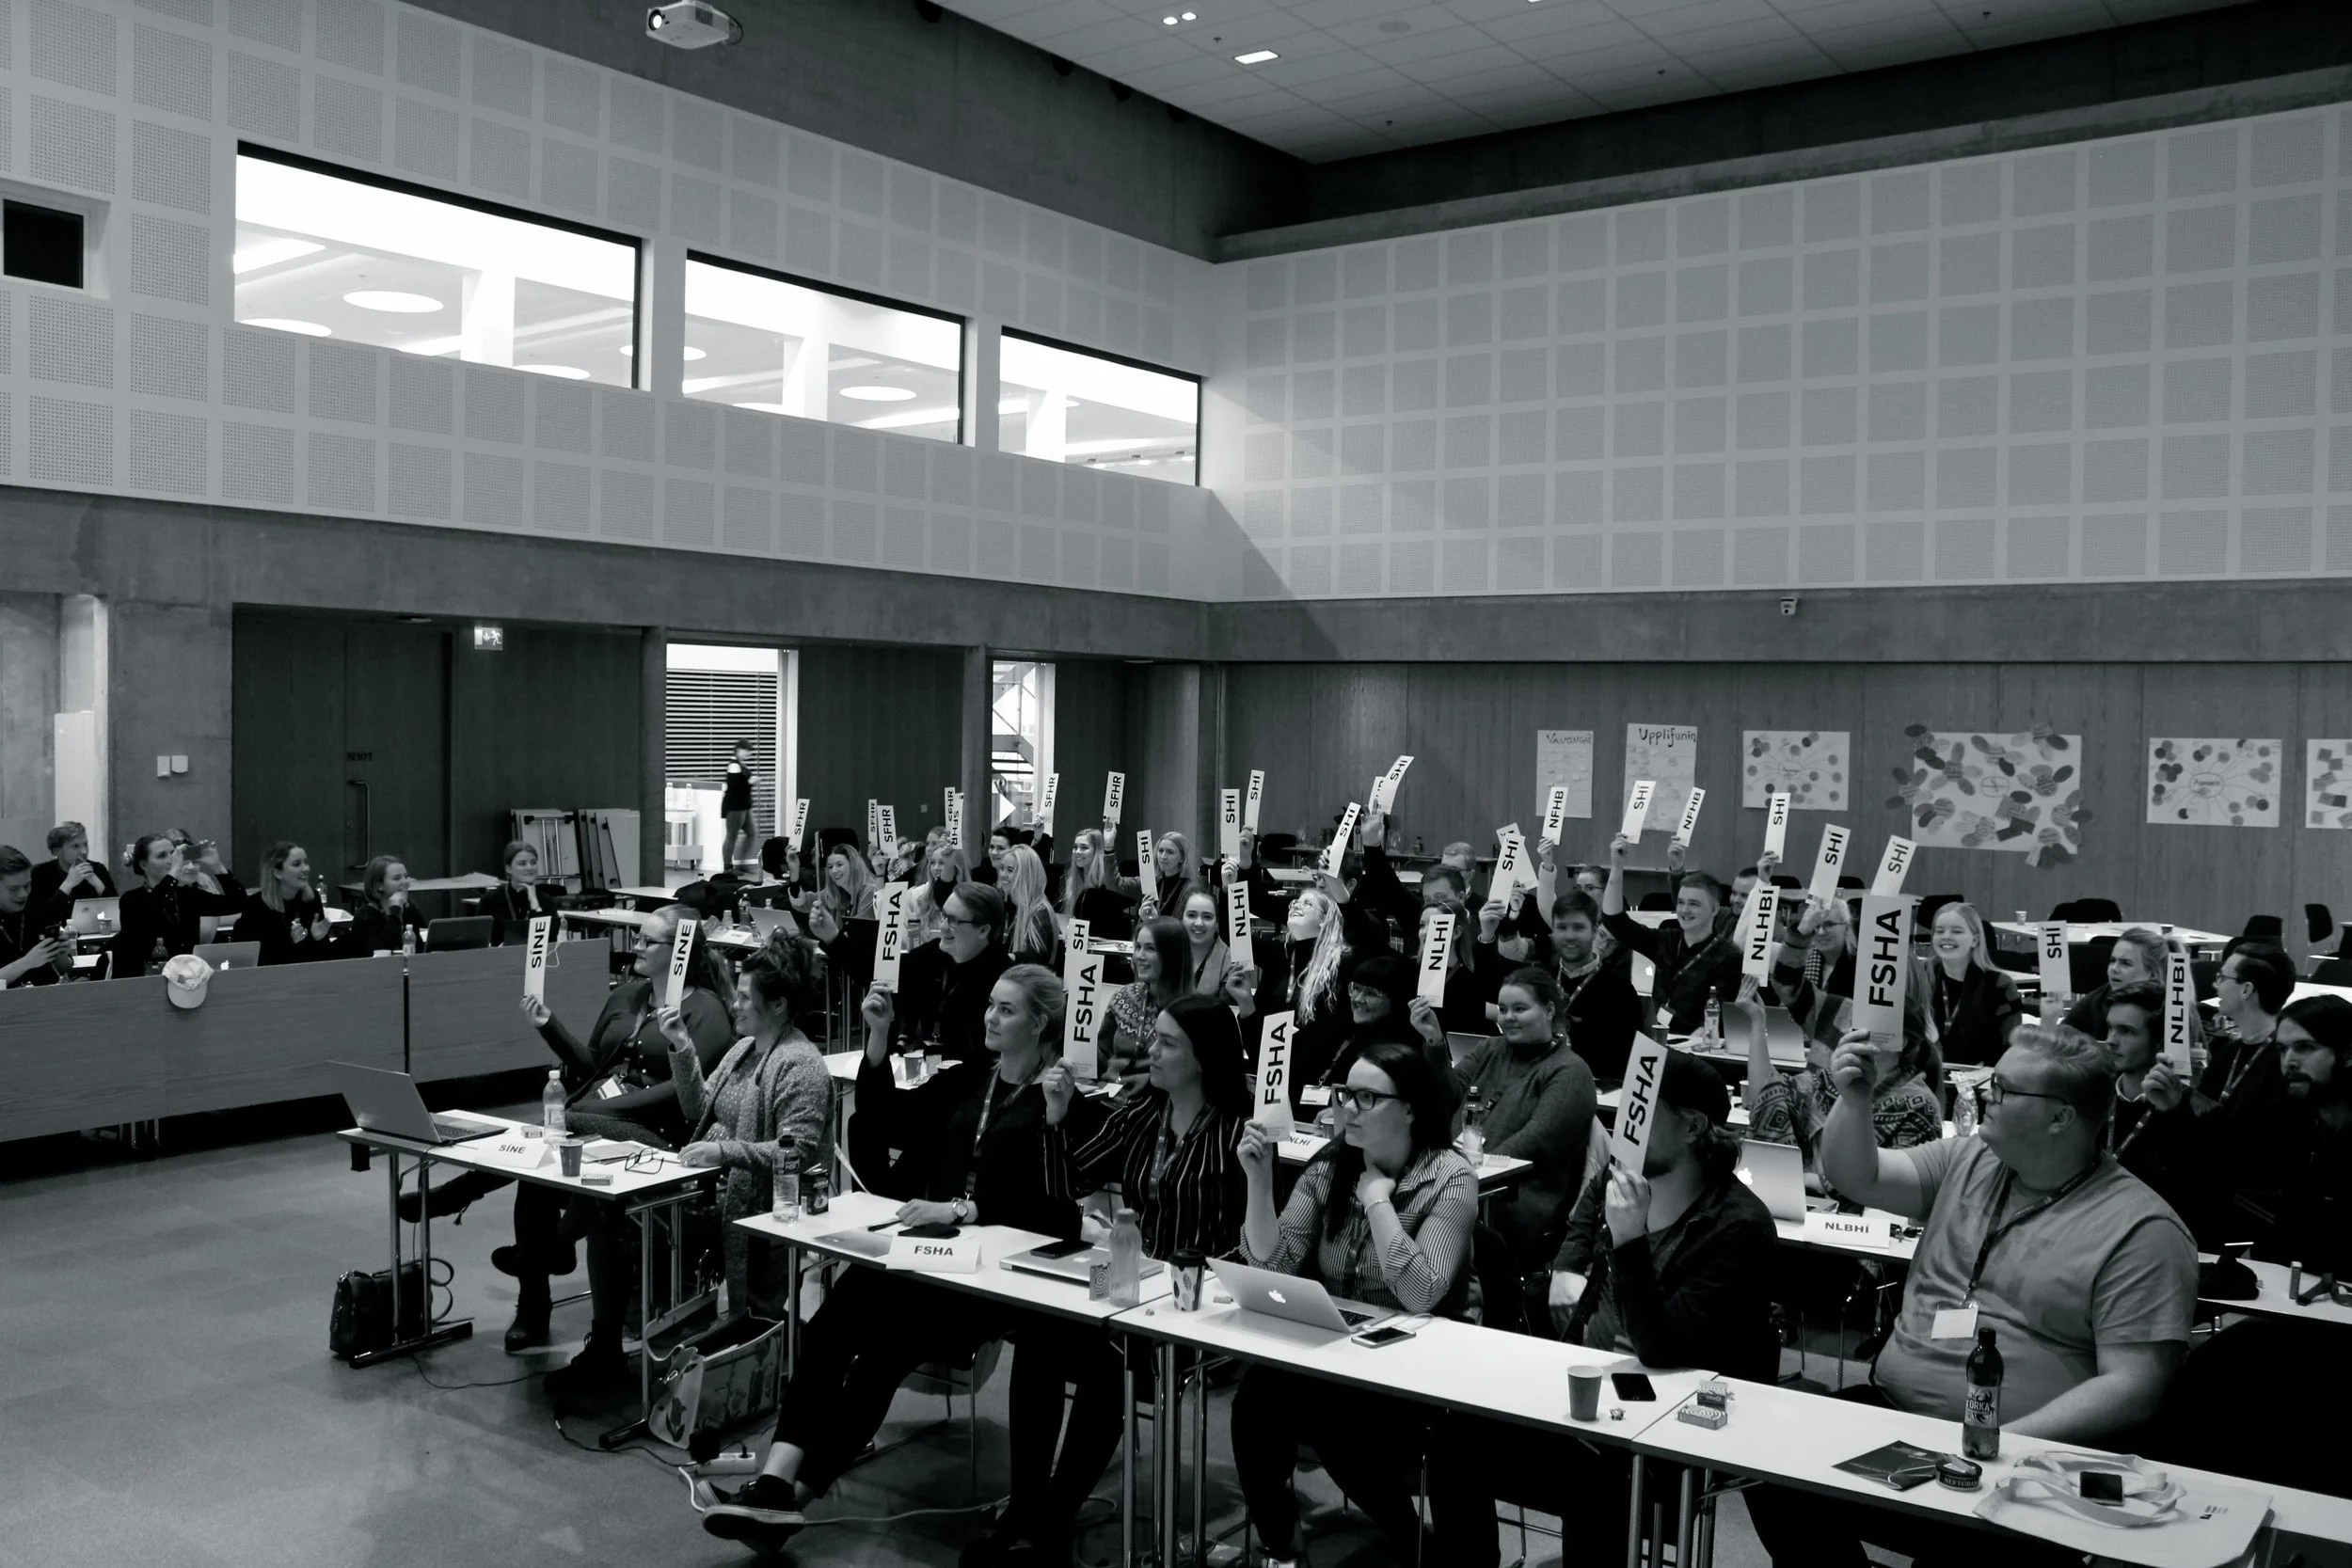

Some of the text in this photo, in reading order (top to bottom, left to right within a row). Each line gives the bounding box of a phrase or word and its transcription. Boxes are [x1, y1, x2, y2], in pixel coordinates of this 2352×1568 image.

[1044, 776, 1056, 808] SFHR
[1109, 775, 1121, 808] SFHR
[1549, 790, 1564, 829] NFHB
[1683, 792, 1701, 830] NFHB
[794, 802, 806, 835] SFHR
[882, 809, 894, 843] SFHR
[882, 890, 902, 961] FSHA
[1231, 888, 1247, 938] NLHÍ
[1751, 889, 1774, 960] NLHBÍ
[531, 921, 547, 968] SÍNE
[674, 925, 691, 976] SÍNE
[1428, 920, 1449, 971] NLHÍ
[1868, 909, 1901, 1007] FSHA
[1073, 964, 1098, 1042] FSHA
[2170, 956, 2185, 1044] NLHBÍ
[1264, 1022, 1288, 1105] FSHA
[1623, 1055, 1659, 1146] FSHA
[914, 1245, 953, 1257] FSHA
